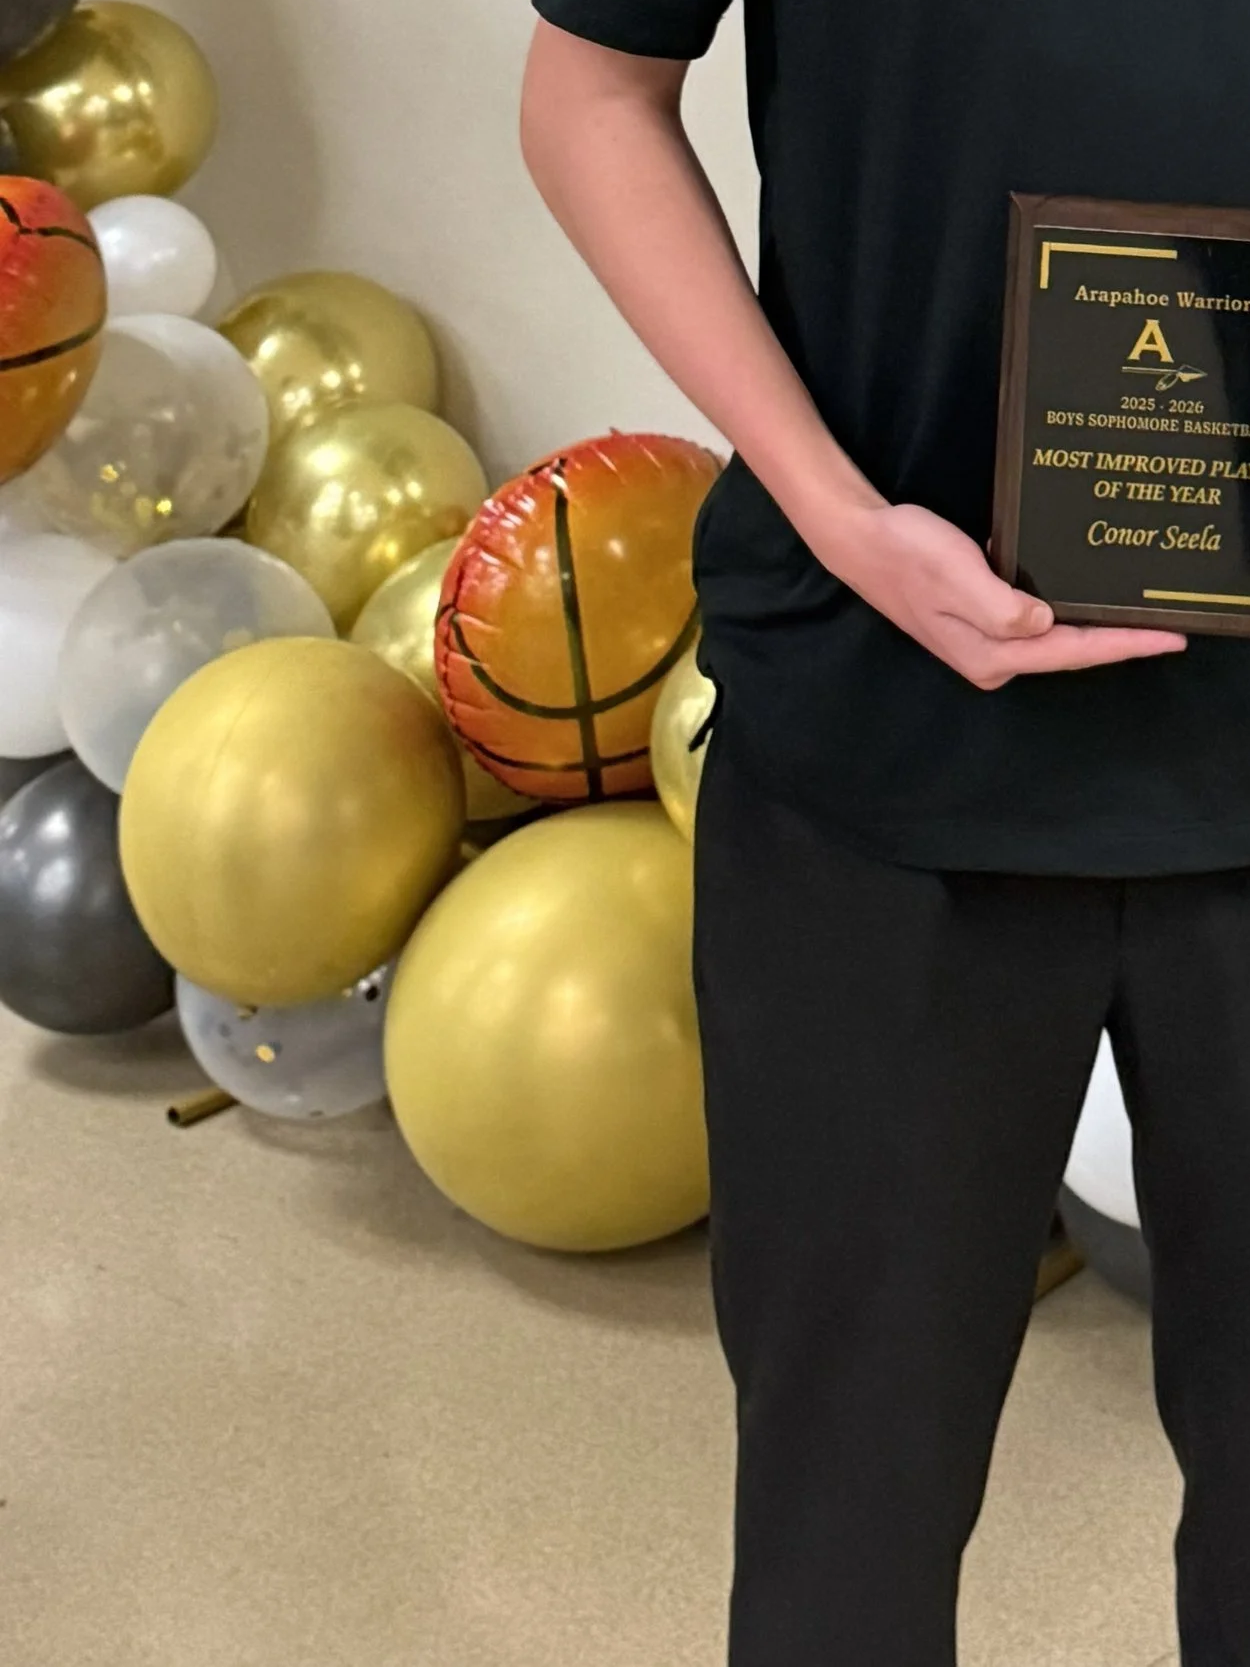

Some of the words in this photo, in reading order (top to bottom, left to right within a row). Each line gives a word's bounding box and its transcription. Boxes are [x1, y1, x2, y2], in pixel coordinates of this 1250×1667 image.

[1074, 284, 1170, 309] Arapahoe
[1127, 318, 1175, 364] A
[1120, 396, 1155, 411] 2025
[1169, 398, 1204, 414] 2026
[1046, 410, 1085, 426] BOYS
[1088, 413, 1179, 432] SOPHOMORE
[1032, 448, 1094, 469] MOST
[1096, 452, 1206, 476] IMPROVED
[1093, 480, 1125, 499] OF
[1128, 481, 1166, 501] THE
[1170, 485, 1221, 505] YEAR
[1087, 520, 1159, 547] Conor
[1160, 525, 1221, 551] Seela
